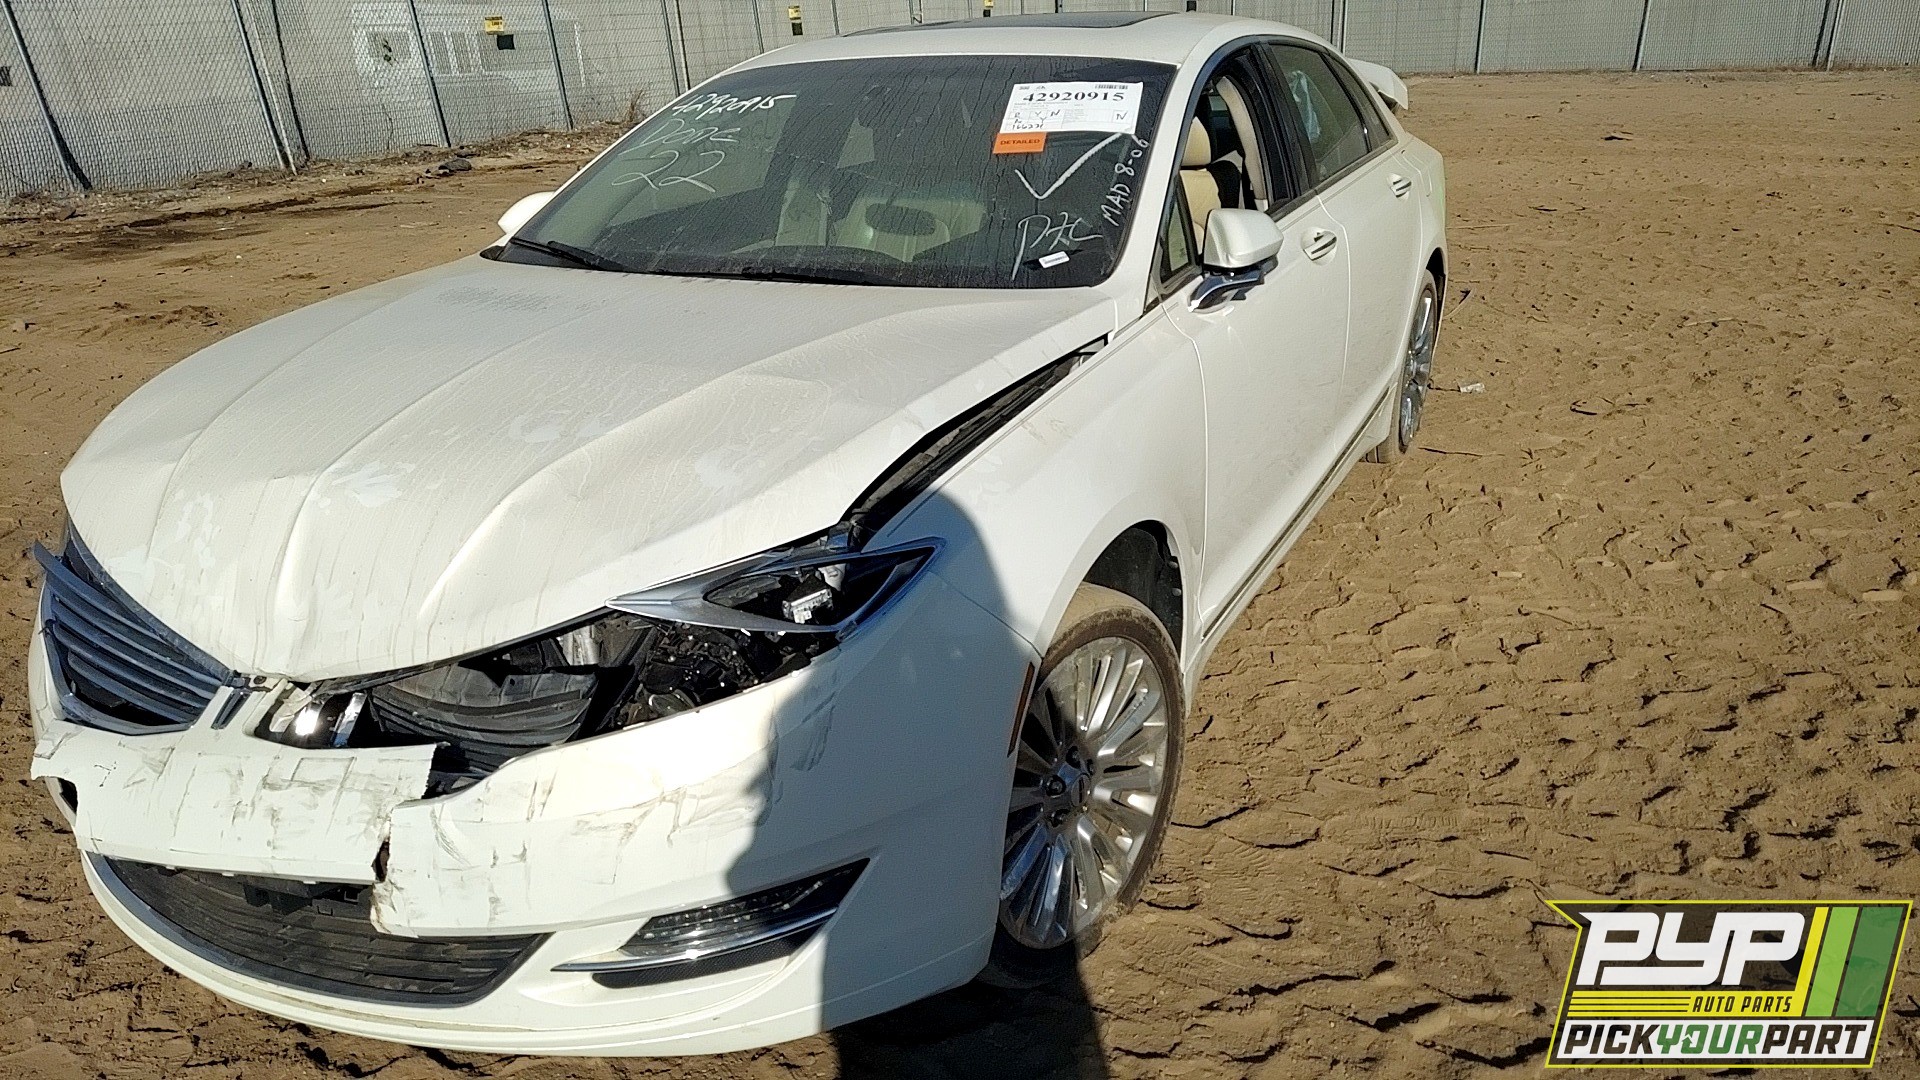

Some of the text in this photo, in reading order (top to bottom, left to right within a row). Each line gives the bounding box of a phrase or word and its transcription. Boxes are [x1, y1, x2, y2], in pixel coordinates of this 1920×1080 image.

[1022, 91, 1125, 102] 42920915
[1000, 138, 1041, 146] DETAILED
[611, 149, 716, 193] 22
[1100, 183, 1132, 227] MAD
